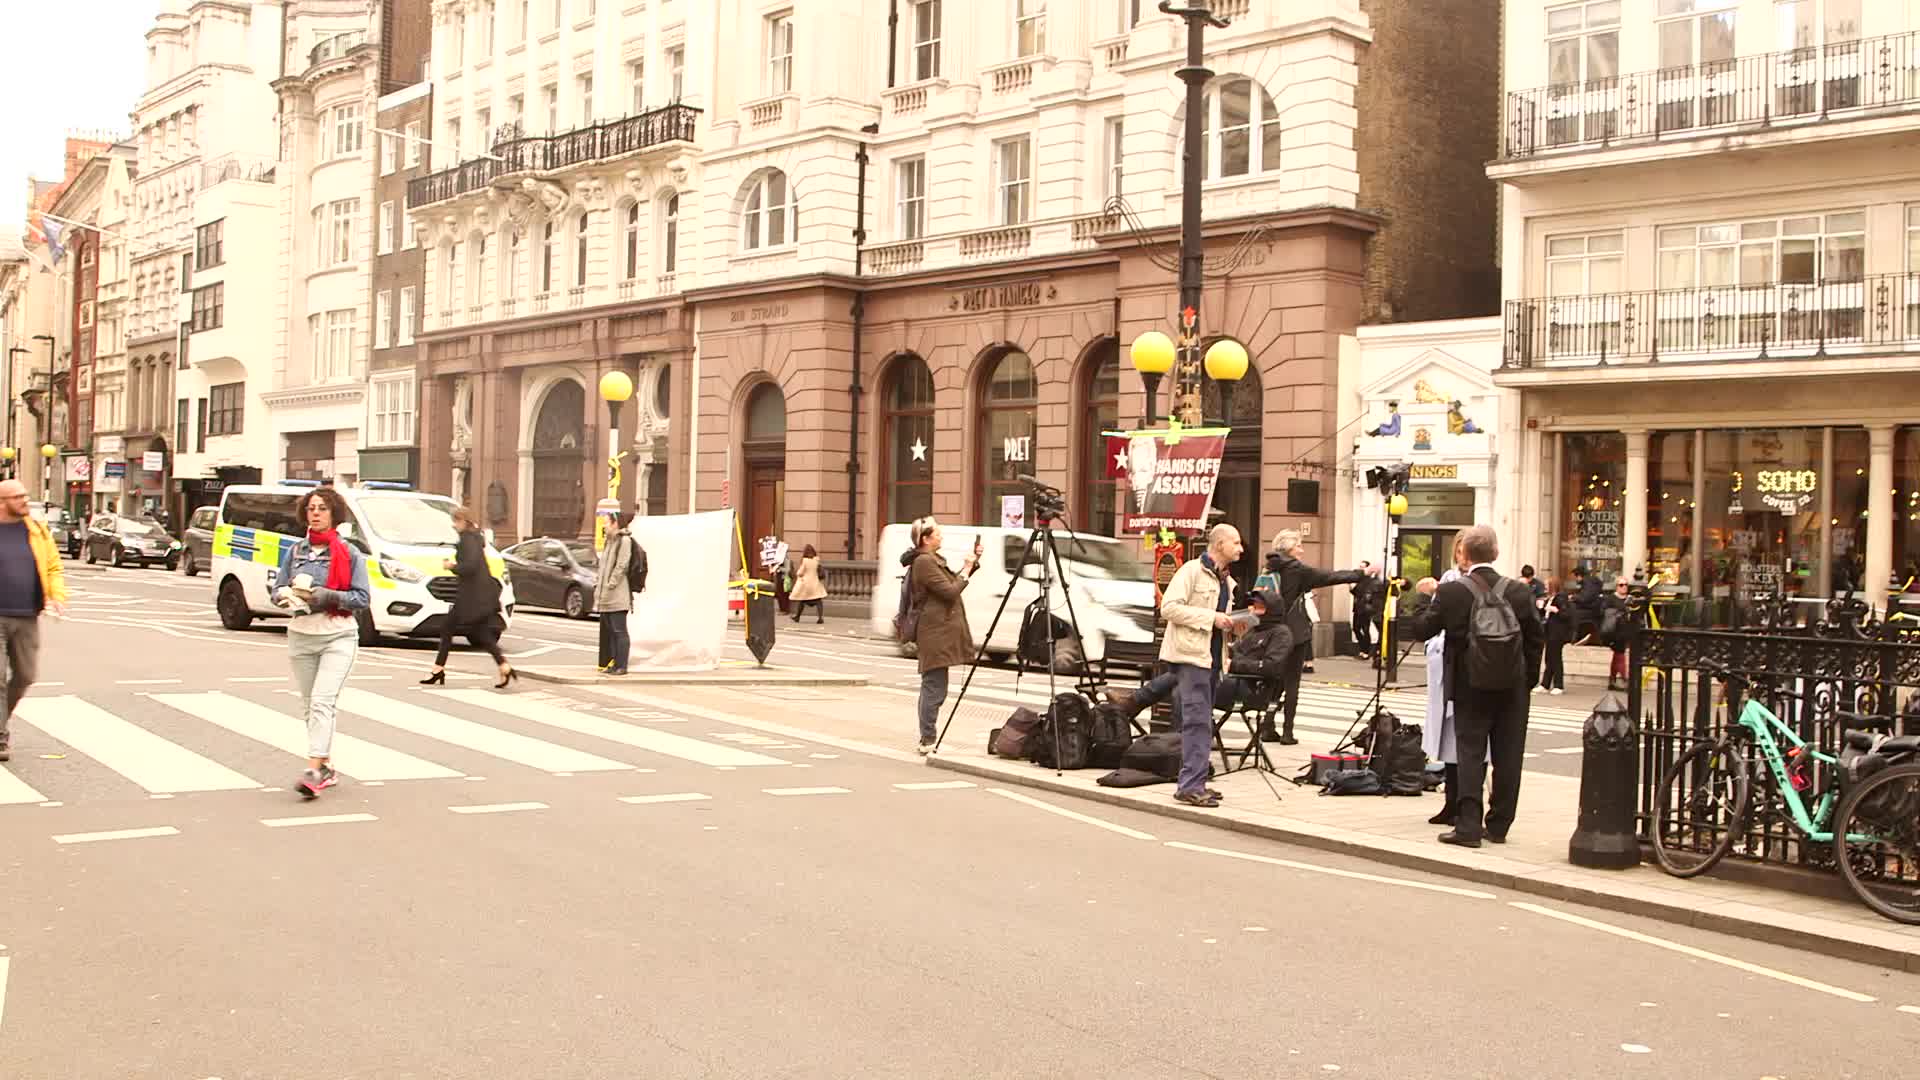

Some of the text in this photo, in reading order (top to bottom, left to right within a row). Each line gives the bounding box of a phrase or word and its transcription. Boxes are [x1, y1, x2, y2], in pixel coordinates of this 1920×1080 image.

[963, 287, 988, 311] PRET
[1000, 281, 1040, 307] MANGER
[751, 304, 789, 321] STRAND
[1004, 437, 1031, 462] PRET
[1156, 458, 1221, 474] HANDS OFF
[1412, 465, 1454, 478] NINGS
[1757, 470, 1817, 492] SOHO
[1762, 494, 1795, 510] COFFEE
